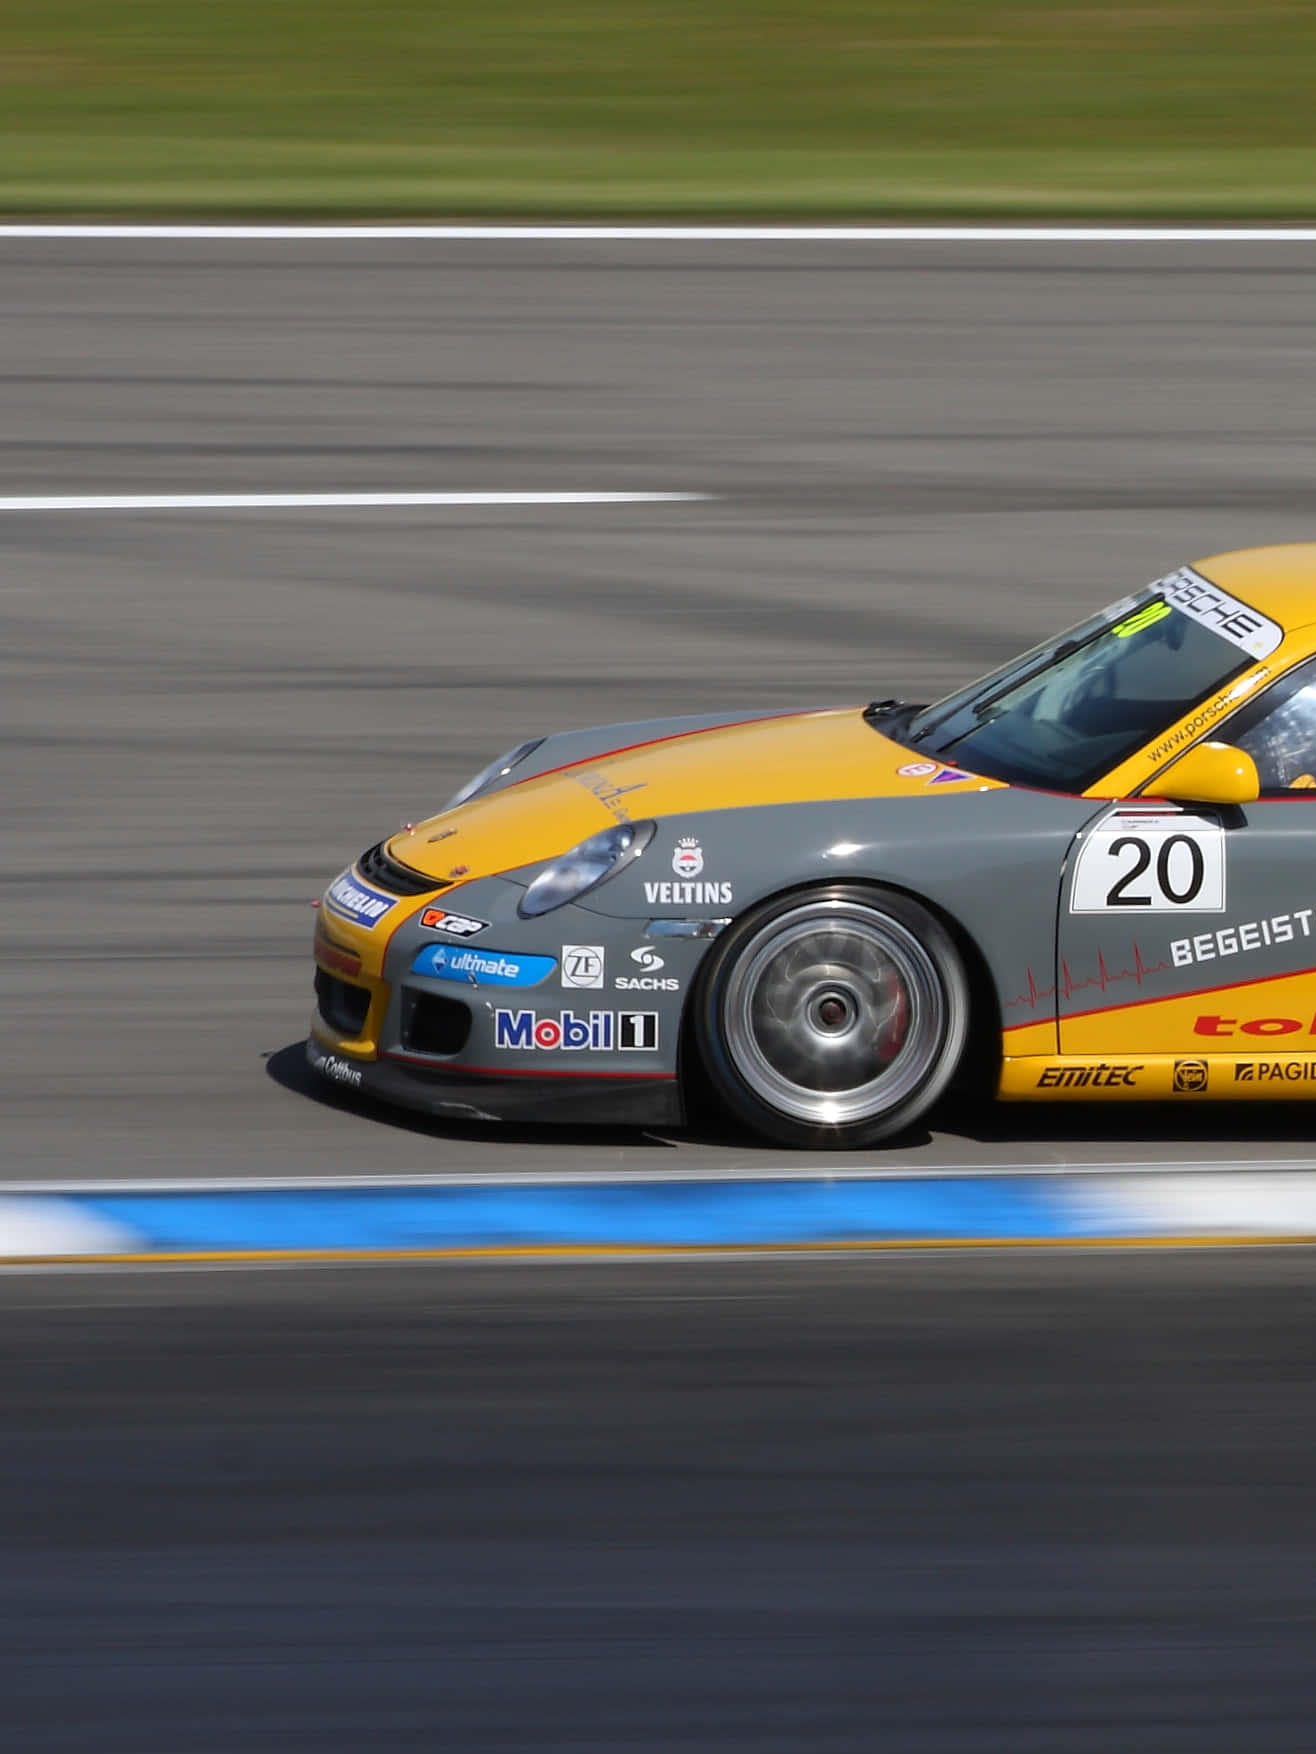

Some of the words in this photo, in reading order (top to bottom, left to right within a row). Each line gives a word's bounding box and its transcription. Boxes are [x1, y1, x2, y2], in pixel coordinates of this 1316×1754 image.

[1106, 834, 1204, 906] 20
[644, 881, 733, 905] VELTINS
[451, 953, 520, 978] ultimate
[615, 977, 680, 992] SACHS
[495, 1008, 614, 1050] Mobil
